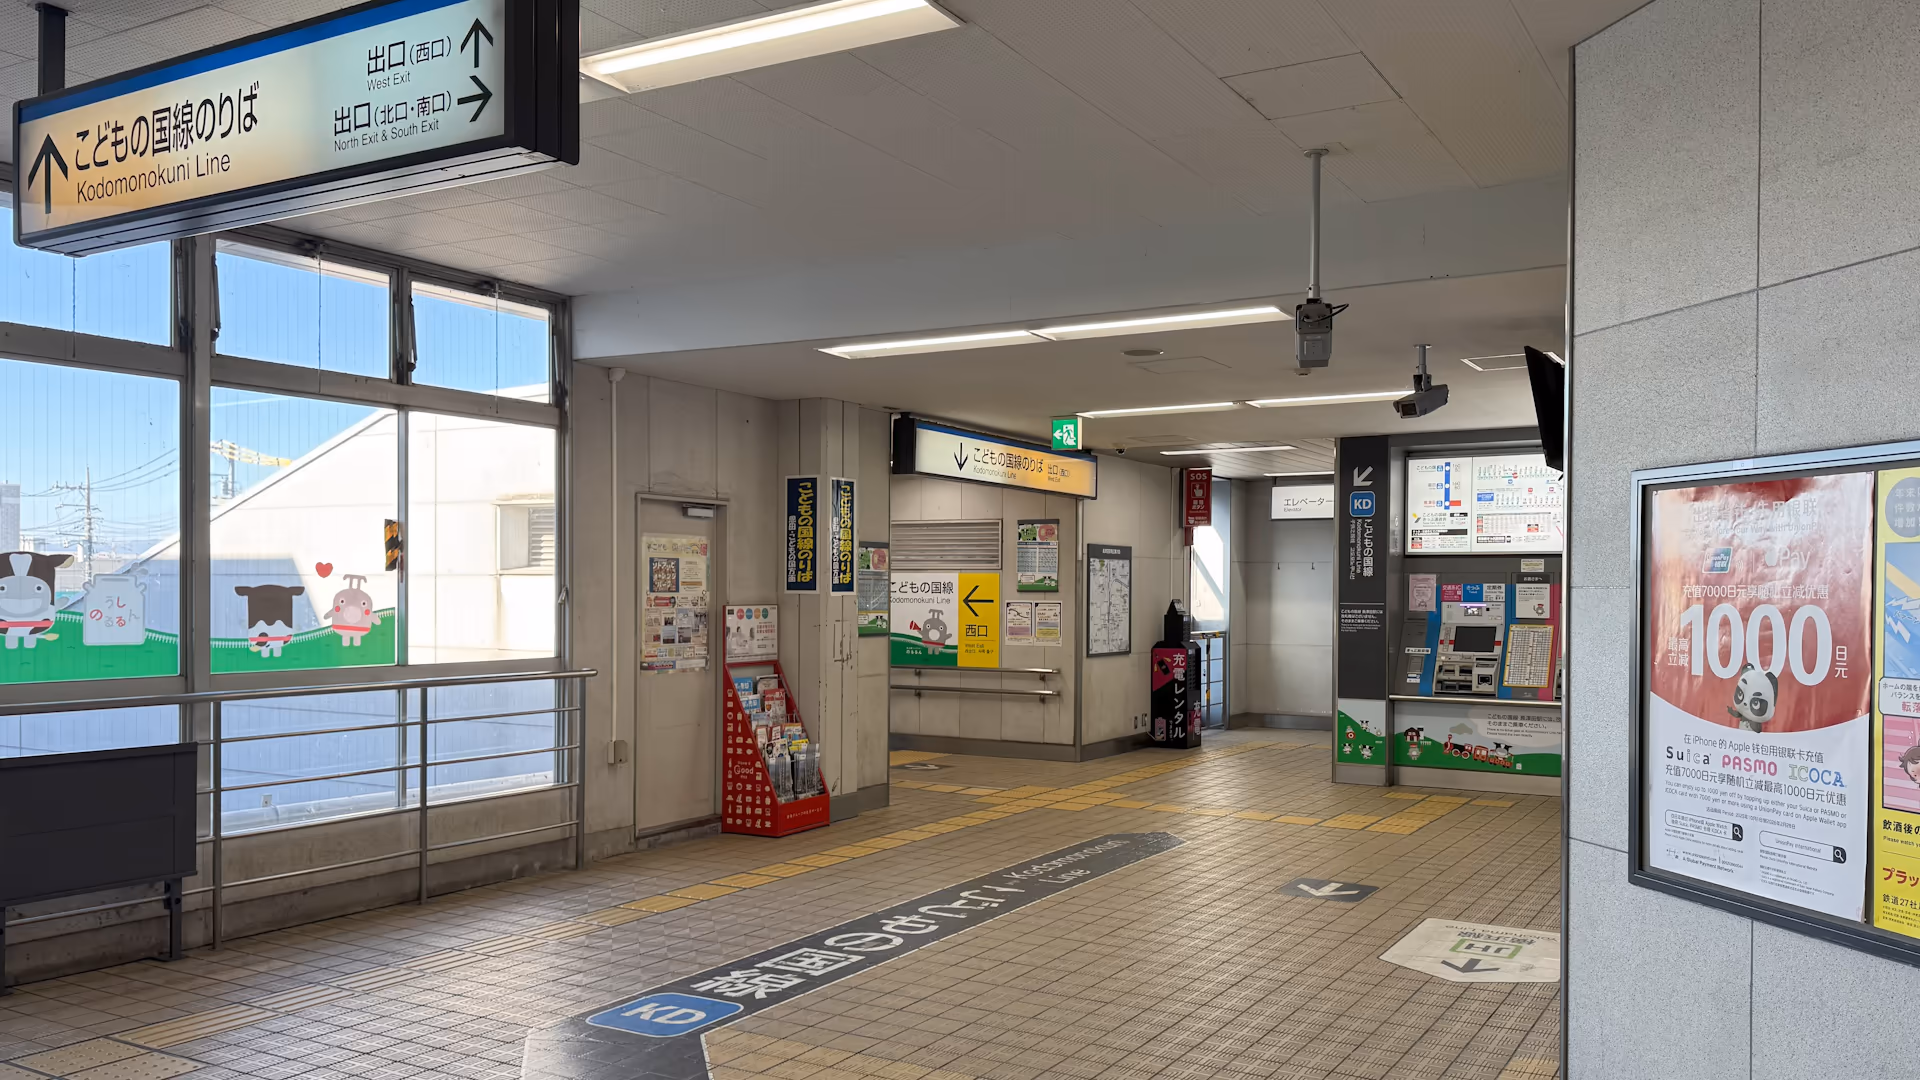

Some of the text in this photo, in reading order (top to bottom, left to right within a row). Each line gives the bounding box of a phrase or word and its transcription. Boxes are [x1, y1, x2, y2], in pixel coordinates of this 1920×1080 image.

[367, 36, 452, 76] 出口（西口）
[367, 71, 411, 91] West Exit
[75, 81, 259, 171] こどもの国線のりば
[334, 119, 439, 152] North Exit & South Exit
[77, 153, 230, 203] Kodomonokuni Line
[973, 448, 1044, 473] こどもの国線のりば
[973, 465, 1017, 480] Kodomonokuni Line
[1283, 497, 1335, 506] エレベーター
[1354, 499, 1373, 510] KD
[798, 482, 814, 582] こどもの国線のりば
[840, 485, 851, 584] こどもの国線のりば
[1363, 519, 1374, 577] こどもの国線
[1780, 548, 1811, 570] Pay
[890, 581, 954, 594] こどもの国線
[936, 596, 951, 604] Line
[965, 624, 988, 637] 西口
[1667, 637, 1689, 652] 最高
[1680, 603, 1832, 686] 1000
[1667, 653, 1689, 667] 立减
[1835, 646, 1848, 678] 日元
[1173, 653, 1186, 738] 充電レンタル
[1666, 746, 1710, 765] Suica
[1684, 734, 1824, 764] 在 iPhone 的 Apple 钱包用银联卡充值
[734, 765, 754, 775] Good
[1722, 755, 1777, 776] PASMO
[1788, 763, 1845, 788] ICOCA
[1665, 764, 1846, 806] 充值7000日元享随机立减最高1000日元优惠
[1665, 787, 1677, 795] ICOCA
[1699, 793, 1711, 801] 7000
[1740, 802, 1753, 811] using
[1758, 805, 1782, 816] UnionPay
[1783, 809, 1794, 818] card
[1802, 814, 1817, 823] Apple
[1818, 816, 1835, 826] Wallet
[1836, 820, 1847, 829] app
[1682, 783, 1693, 791] enjoy
[1707, 787, 1718, 795] 1000
[1737, 792, 1743, 800] by
[1770, 799, 1785, 807] either
[1786, 802, 1798, 810] your
[1799, 804, 1812, 813] Suica
[1820, 808, 1840, 818] PASMO
[1882, 819, 1920, 836] 飲酒後の
[1775, 837, 1794, 848] UnionPay
[1883, 835, 1899, 843] Please
[1900, 839, 1914, 847] watch
[1686, 857, 1699, 865] Global
[1699, 861, 1716, 870] Payment
[1716, 864, 1734, 873] Network
[1038, 868, 1091, 885] Line
[1882, 867, 1920, 888] プラッ
[1882, 893, 1920, 910] 鉄道27社
[690, 885, 1026, 1000] こどもの国線
[1464, 943, 1510, 954] JH
[621, 1003, 707, 1025] KD
